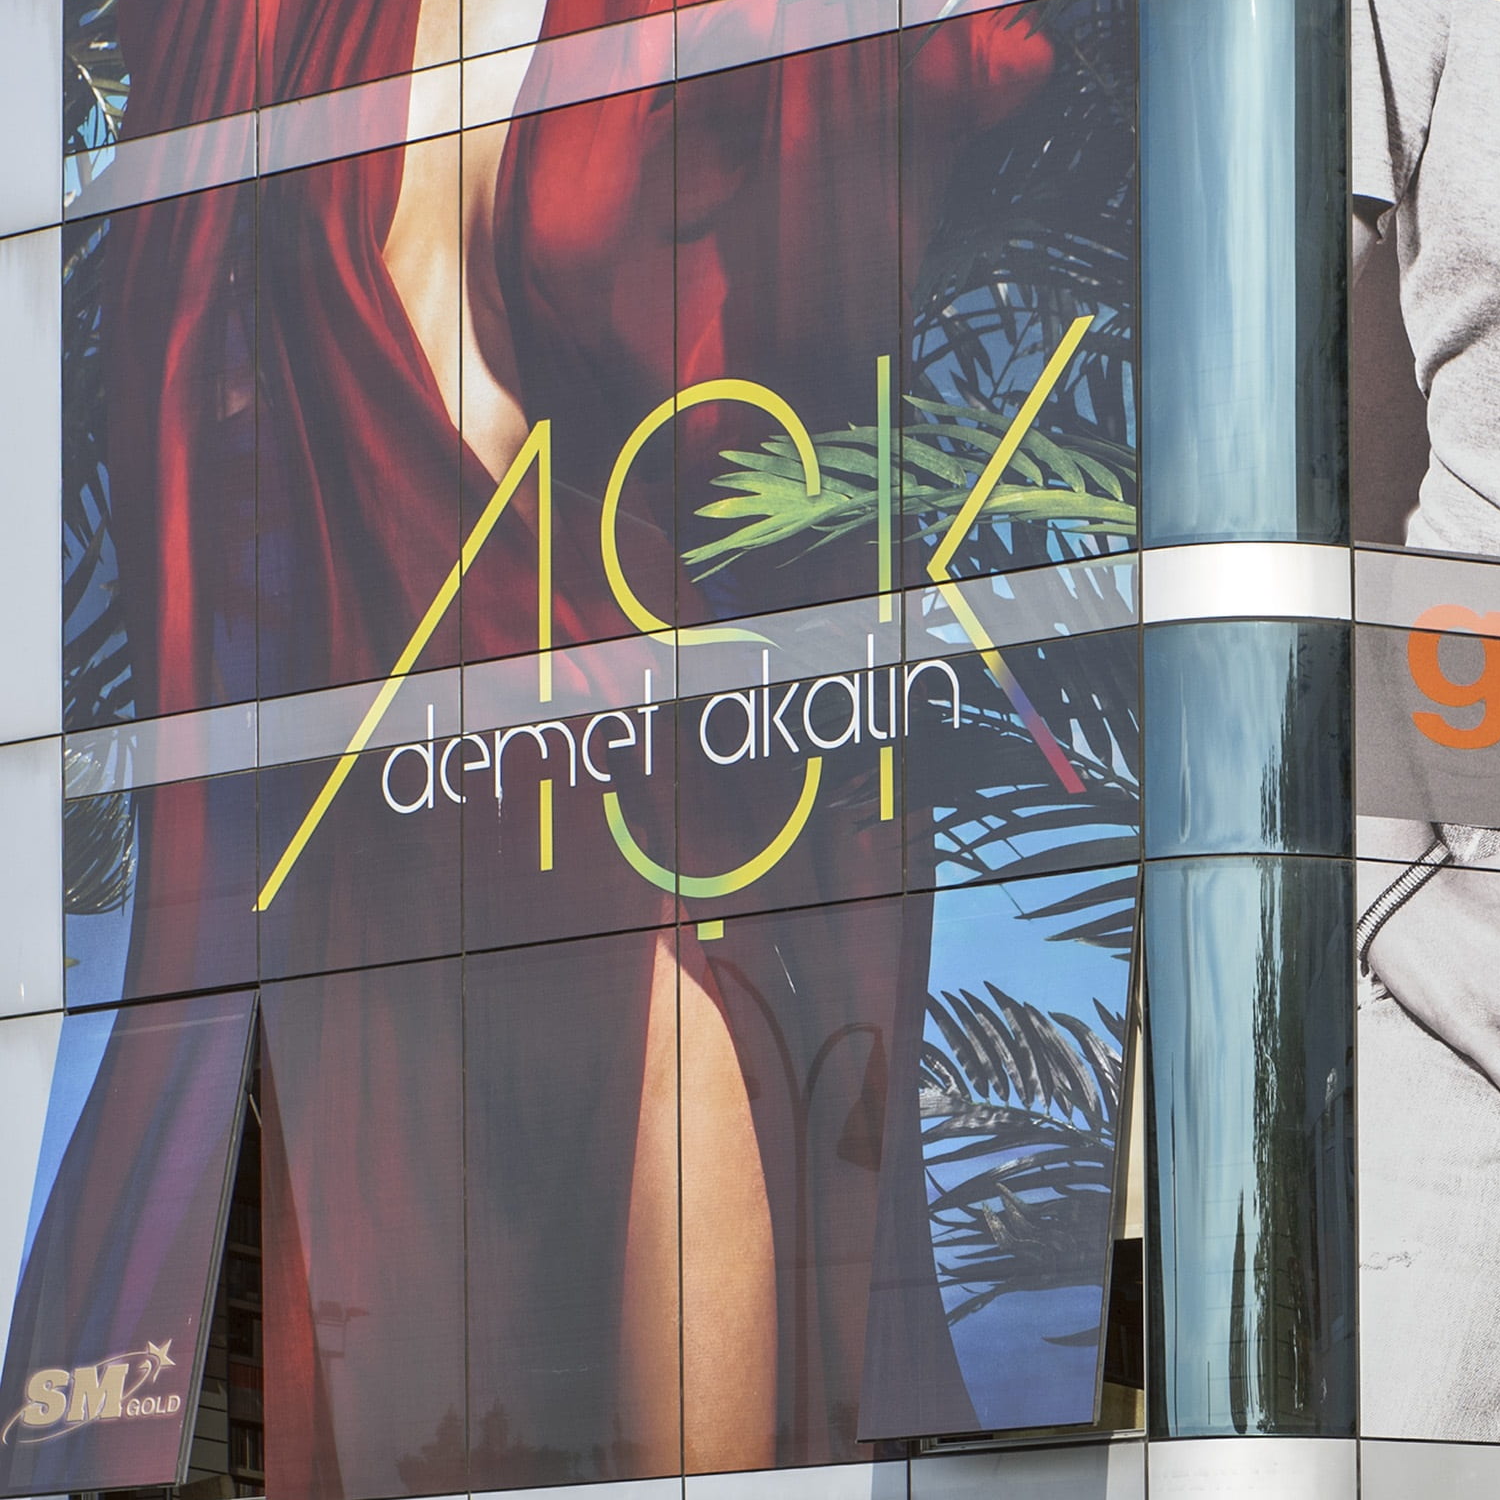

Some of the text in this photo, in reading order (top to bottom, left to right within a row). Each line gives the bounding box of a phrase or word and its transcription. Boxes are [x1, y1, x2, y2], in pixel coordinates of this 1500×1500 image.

[381, 668, 656, 815] demet
[22, 1363, 181, 1427] SM GOLD
